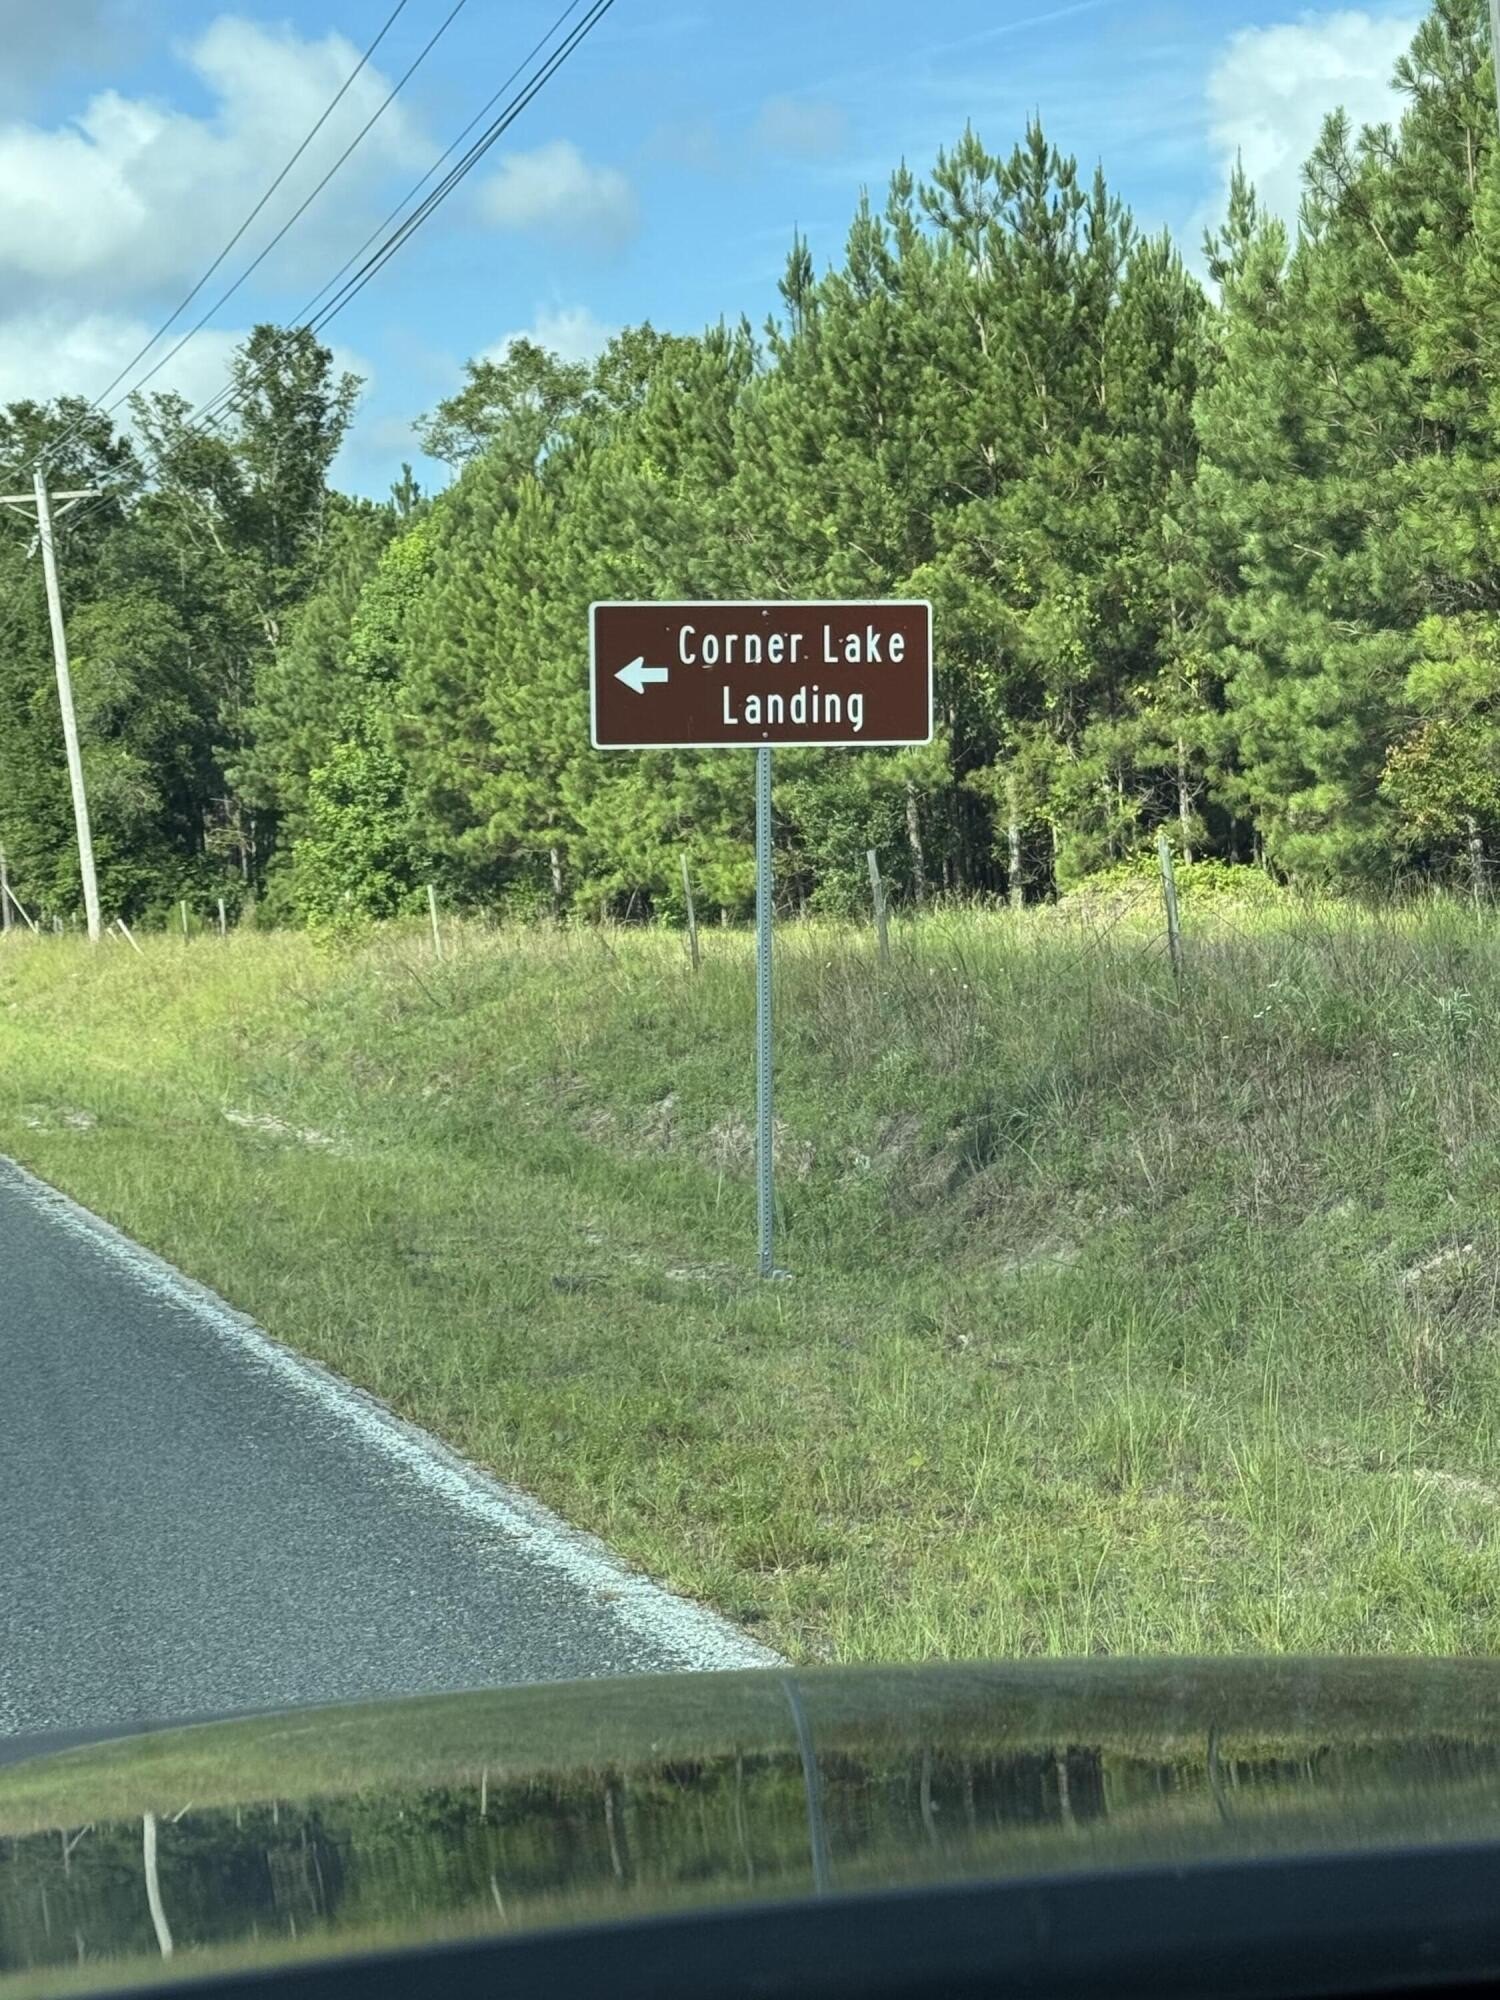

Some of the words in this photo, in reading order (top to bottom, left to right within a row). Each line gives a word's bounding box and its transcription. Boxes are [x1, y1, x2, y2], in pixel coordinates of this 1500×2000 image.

[678, 624, 803, 665] Corner
[823, 624, 905, 663] Lake
[723, 684, 864, 733] Landing
